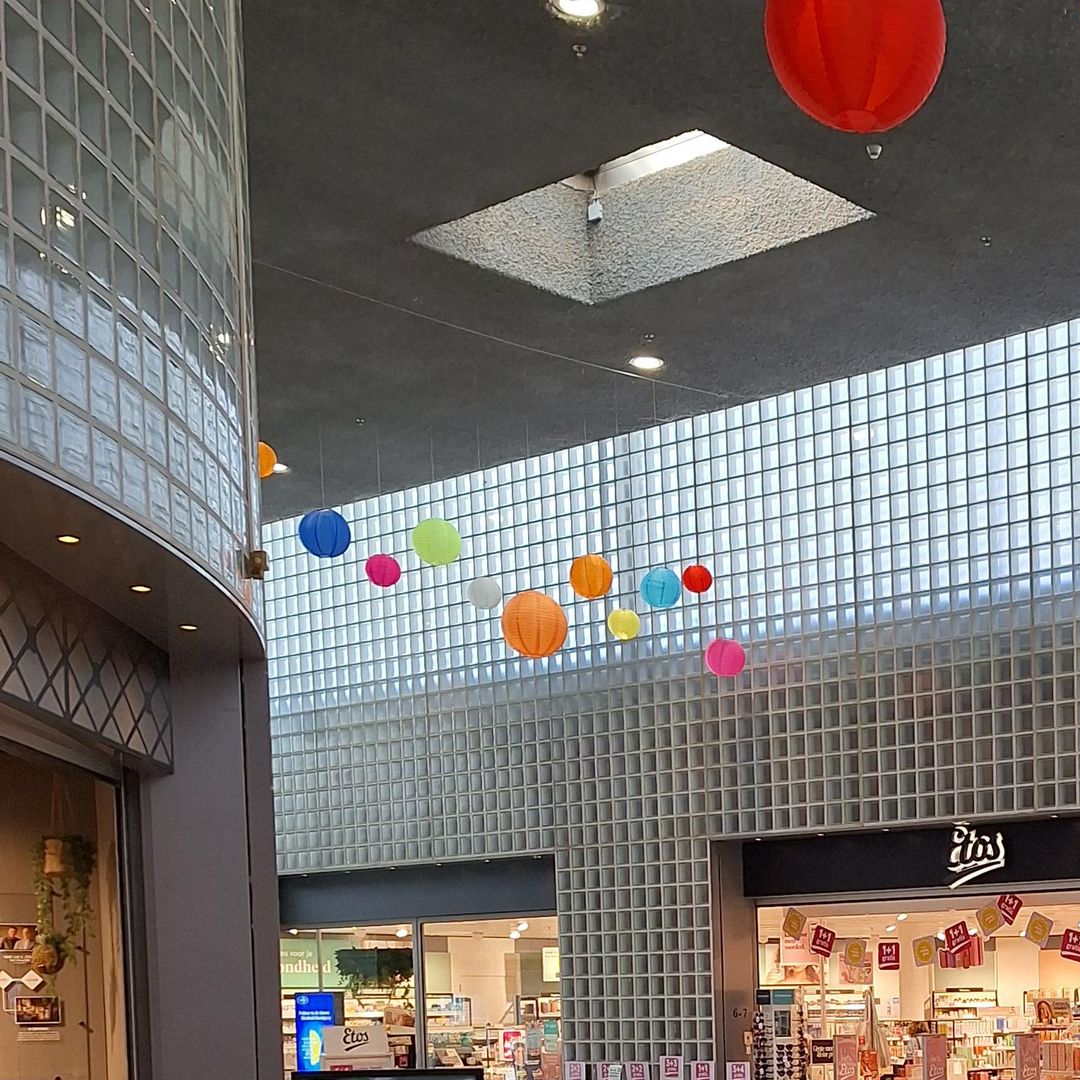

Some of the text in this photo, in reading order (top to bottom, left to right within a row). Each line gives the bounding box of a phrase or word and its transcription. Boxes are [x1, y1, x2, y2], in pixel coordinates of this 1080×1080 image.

[818, 928, 832, 944] 1+1
[949, 925, 963, 940] 1+1
[881, 944, 896, 955] 1+1
[342, 1028, 370, 1052] Etos
